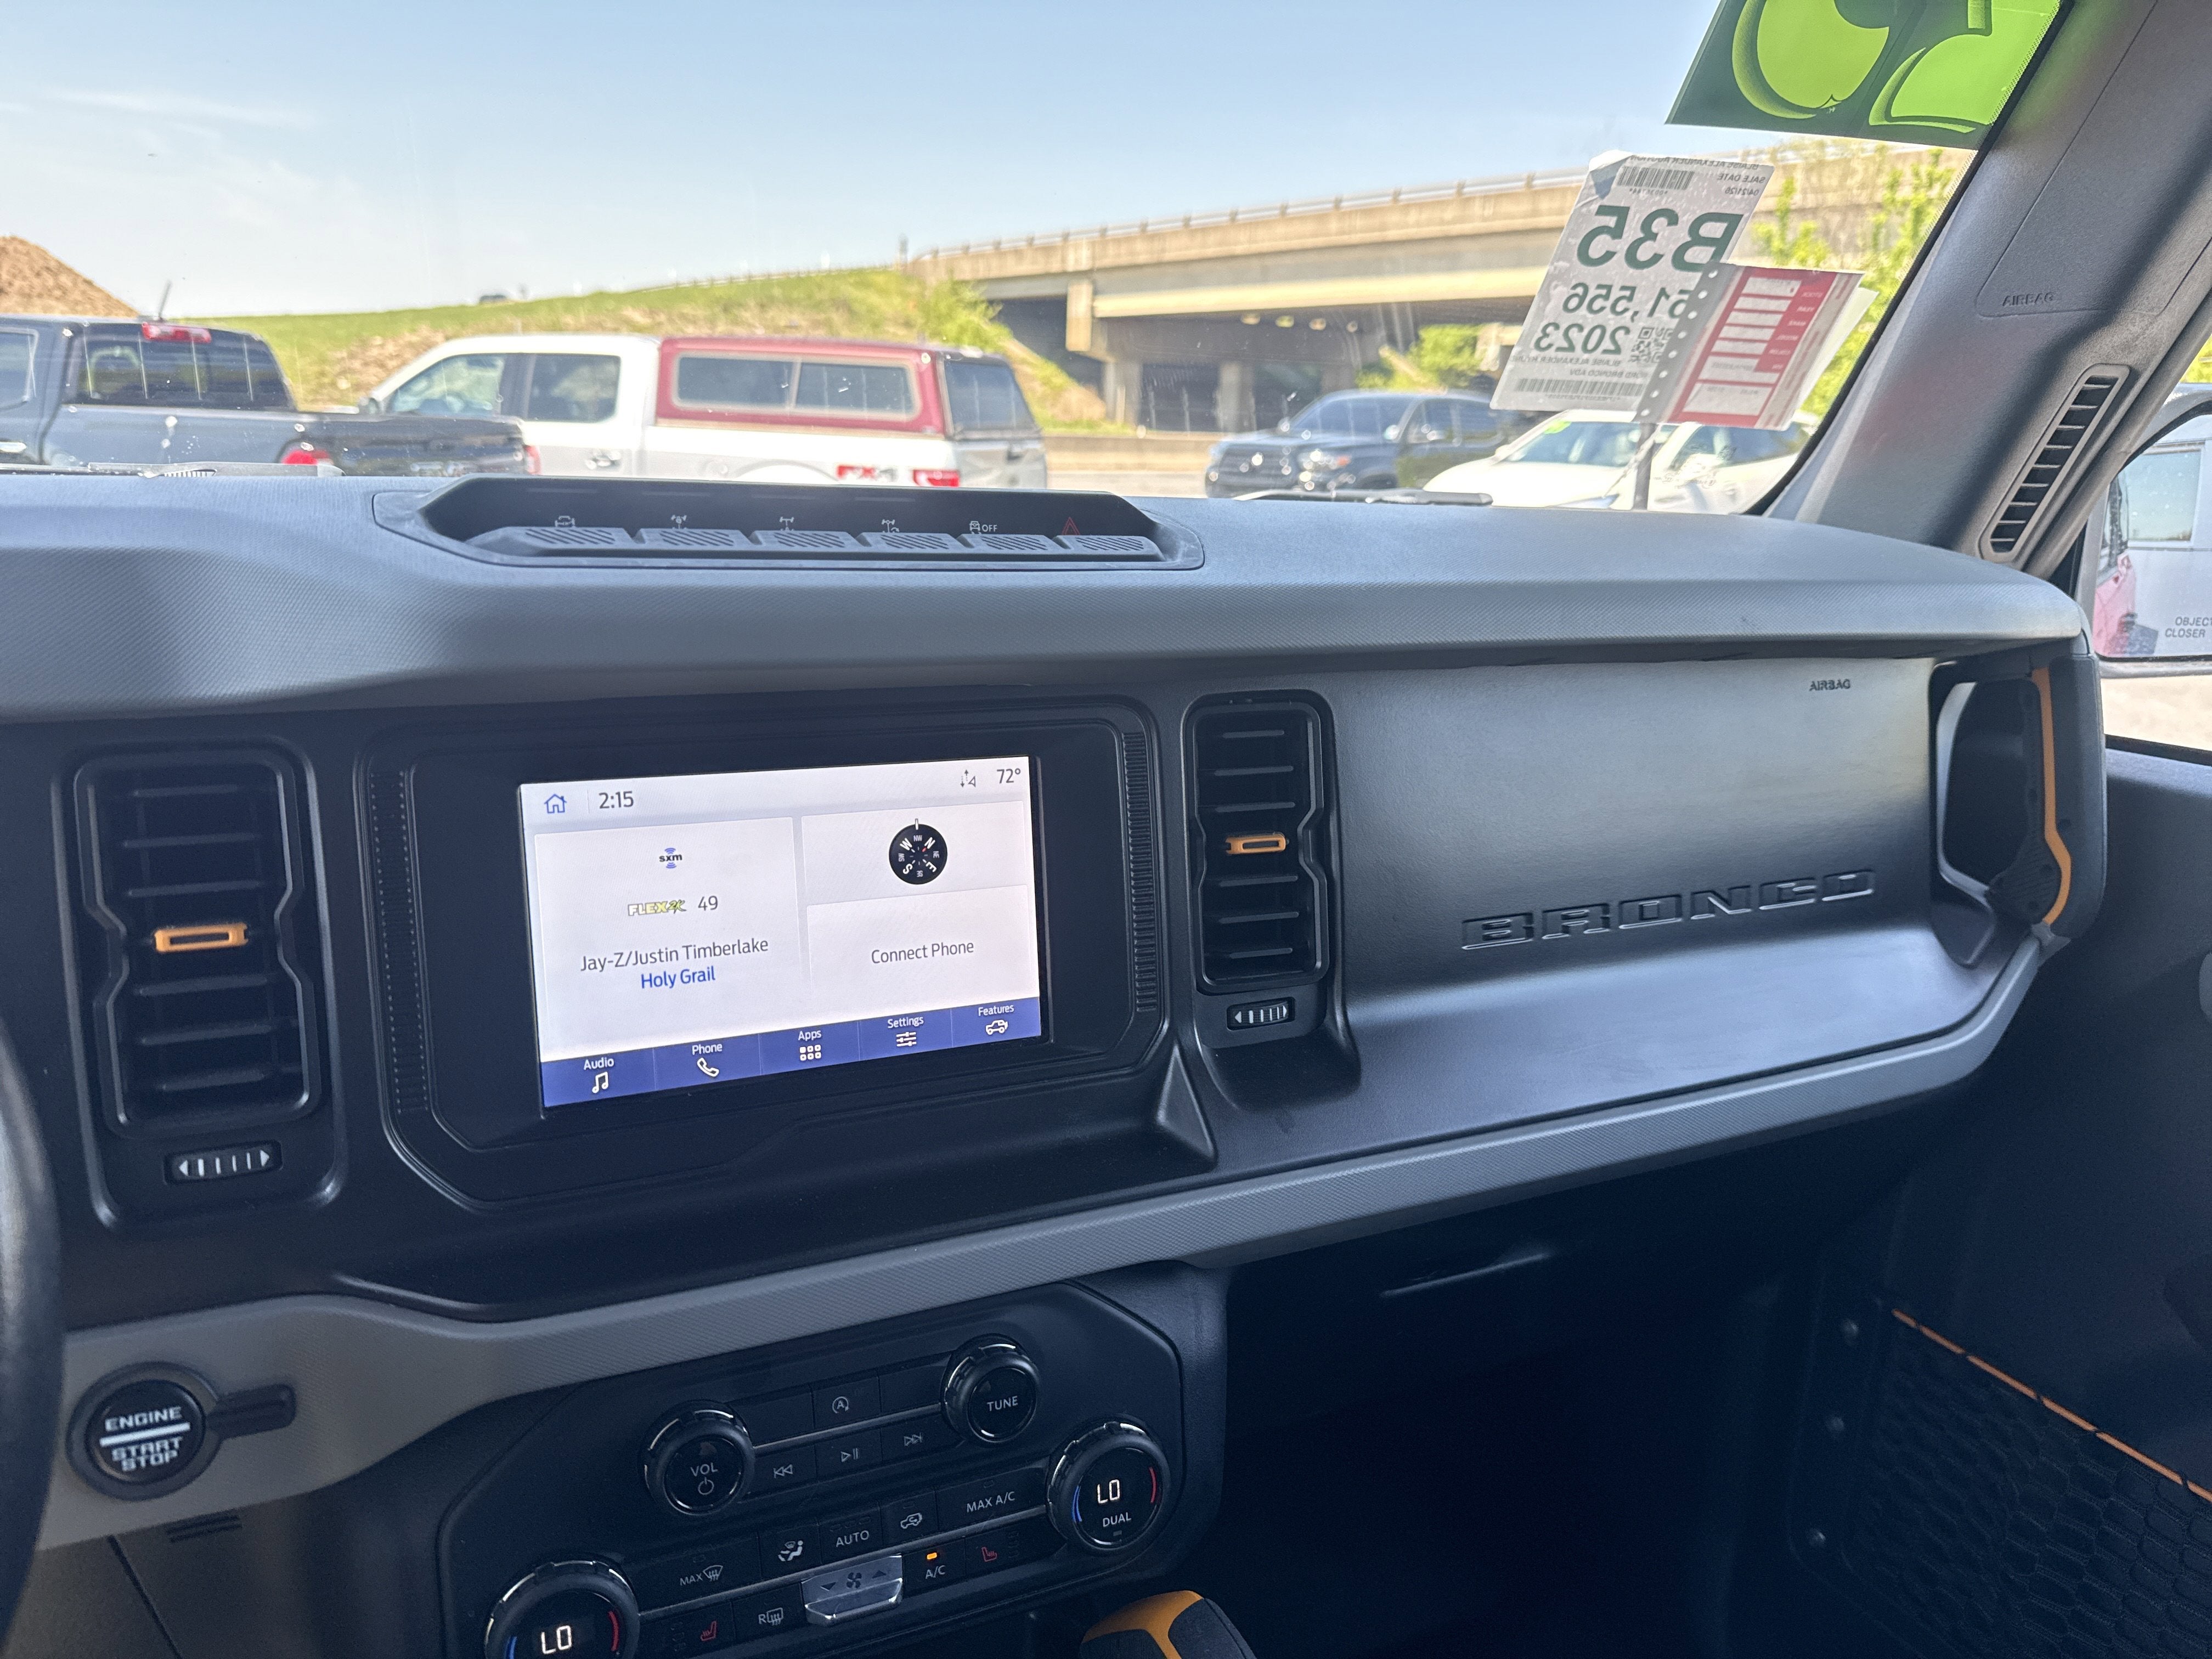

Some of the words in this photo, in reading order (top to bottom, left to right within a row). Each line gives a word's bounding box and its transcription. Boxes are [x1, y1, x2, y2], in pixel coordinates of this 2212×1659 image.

[2002, 292, 2055, 307] AIRBAG
[981, 524, 998, 532] OFF
[2164, 628, 2205, 637] CLOSER
[1809, 679, 1851, 691] AIRBAG
[996, 768, 1022, 785] 72°
[599, 791, 634, 809] 2:15
[900, 838, 912, 851] W
[924, 837, 935, 849] N
[659, 854, 682, 862] sxm
[902, 864, 913, 874] S
[926, 861, 937, 872] E
[698, 895, 718, 911] 49
[1462, 870, 1874, 950] BRONCO
[580, 946, 679, 972] Jay-Z/Justin
[682, 938, 769, 960] Timberlake
[871, 945, 928, 964] Connect
[931, 941, 974, 957] Phone
[640, 972, 676, 989] Holy
[681, 966, 716, 984] Grail
[978, 1003, 1014, 1016] Features
[887, 1014, 924, 1029] Settings
[798, 1029, 822, 1042] Apps
[692, 1042, 723, 1054] Phone
[584, 1057, 614, 1070] Audio
[987, 1396, 1019, 1412] TUNE
[105, 1406, 183, 1432] ENGINE
[112, 1437, 182, 1462] START
[121, 1450, 178, 1472] STOP
[690, 1463, 718, 1477] VOL
[966, 1497, 994, 1513] MAX
[996, 1491, 1015, 1505] A/C
[1102, 1513, 1132, 1527] DUAL
[836, 1530, 870, 1547] AUTO
[679, 1573, 703, 1585] MAX
[925, 1565, 946, 1579] A/C
[759, 1613, 766, 1623] R
